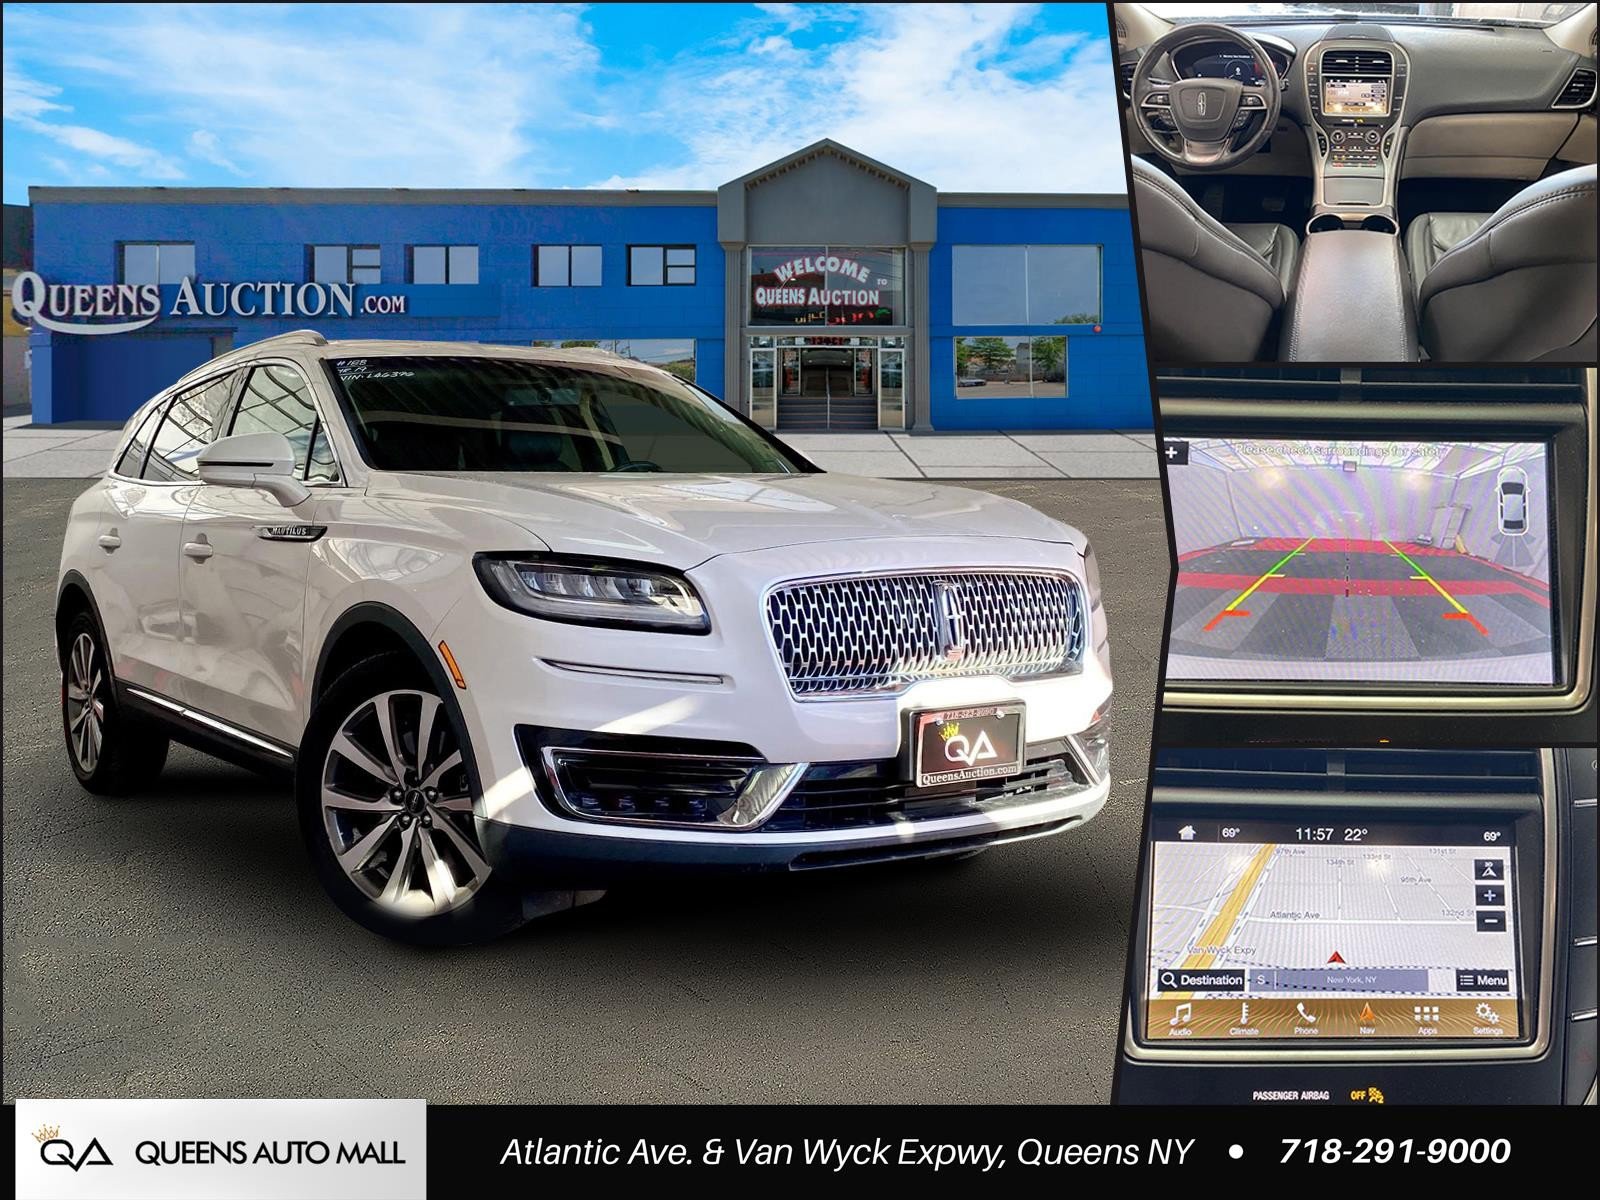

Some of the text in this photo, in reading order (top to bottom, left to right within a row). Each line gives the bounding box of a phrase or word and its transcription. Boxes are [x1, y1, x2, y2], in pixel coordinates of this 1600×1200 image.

[773, 256, 871, 283] WELCOME
[755, 286, 880, 306] QUEENS AUCTION
[12, 271, 161, 335] QUEENS
[1234, 443, 1274, 455] Please
[1276, 443, 1312, 456] check
[1313, 444, 1390, 458] surroundings
[1391, 445, 1408, 456] for
[271, 527, 307, 536] NAUTILUS
[944, 730, 998, 767] QA
[922, 765, 1018, 785] QueensAuction.com
[1295, 827, 1334, 841] 11:57
[1344, 828, 1368, 841] 22°
[1419, 876, 1432, 884] Ave
[1269, 911, 1321, 920] Atlantic Ave
[1187, 945, 1257, 956] Van Wyck Expy
[1180, 974, 1243, 986] Destination
[1257, 975, 1266, 986] S
[1327, 975, 1378, 986] New York, NY
[1477, 974, 1508, 986] Menu
[1168, 1027, 1192, 1037] Audio
[1229, 1027, 1260, 1036] Climate
[1294, 1027, 1319, 1036] Phone
[1359, 1026, 1376, 1035] Nav
[1417, 1026, 1439, 1037] Apps
[1472, 1026, 1504, 1037] Settings
[1252, 1090, 1330, 1101] PASSENGER AIRBAG
[1350, 1090, 1366, 1101] OFF
